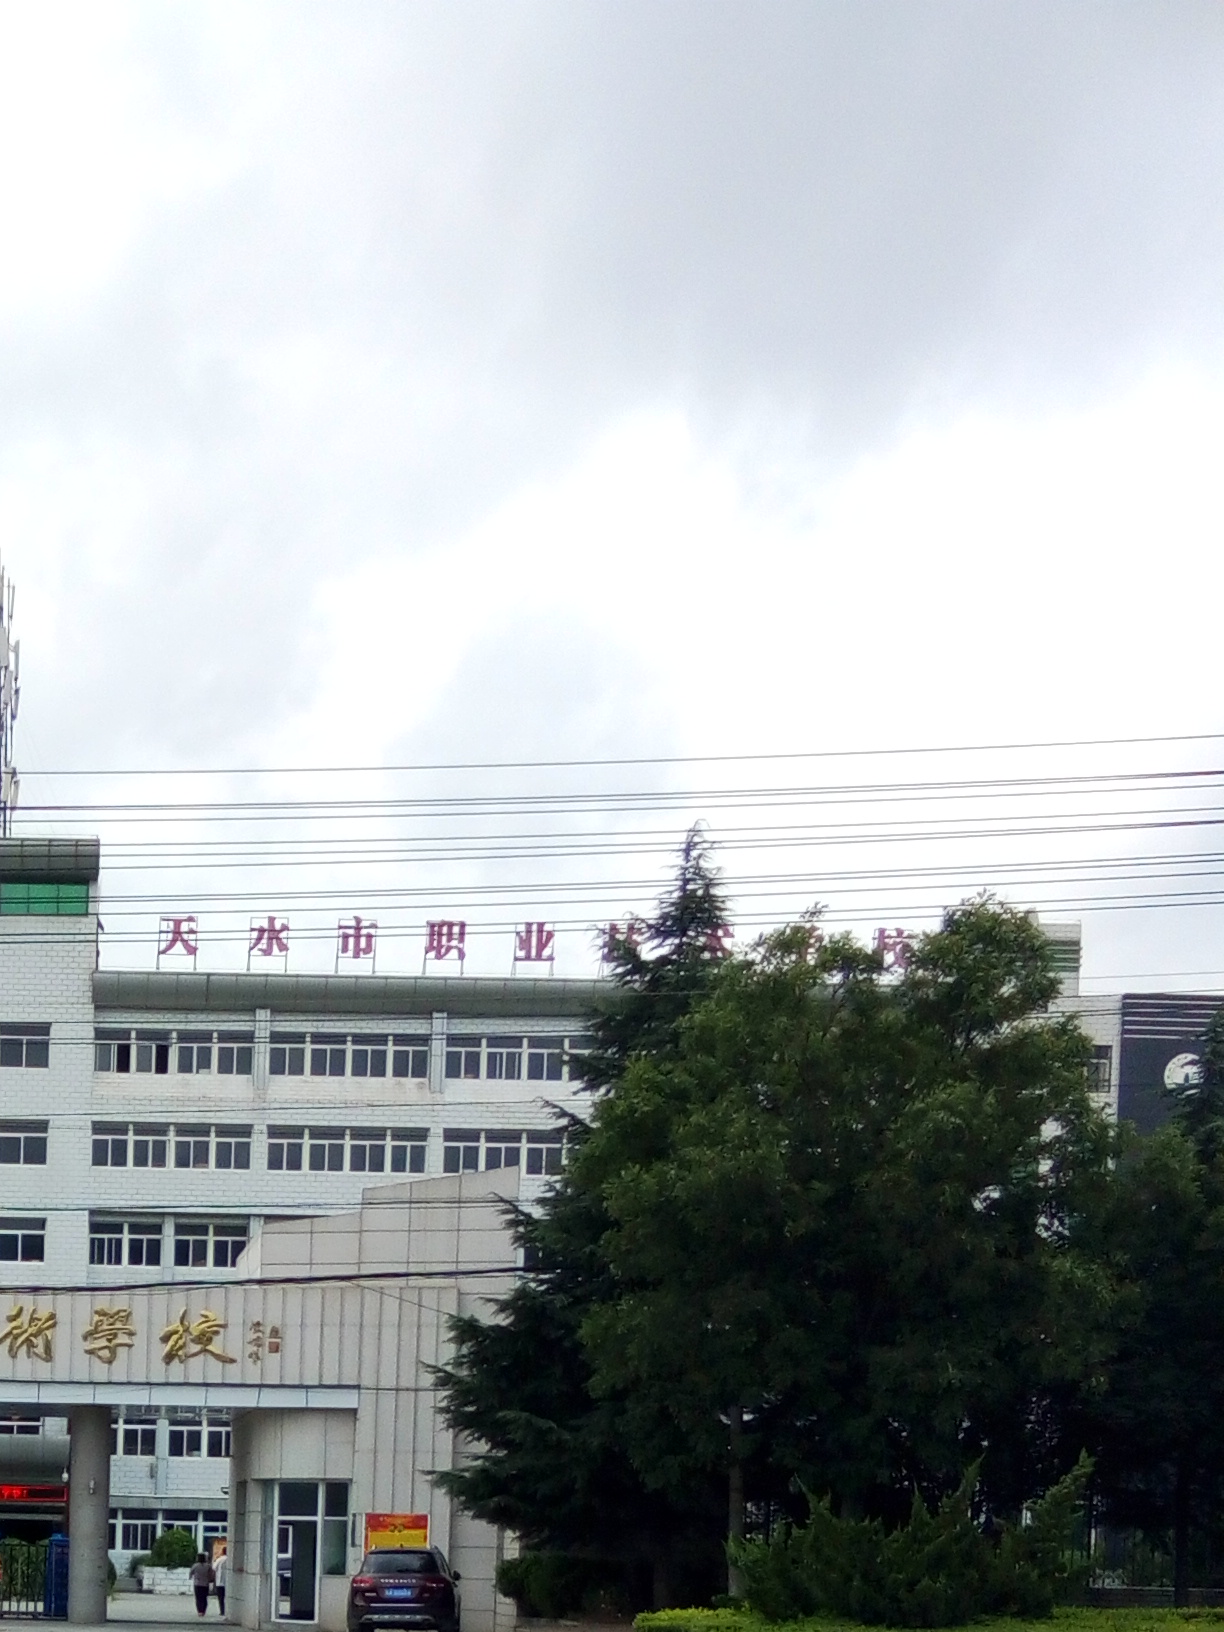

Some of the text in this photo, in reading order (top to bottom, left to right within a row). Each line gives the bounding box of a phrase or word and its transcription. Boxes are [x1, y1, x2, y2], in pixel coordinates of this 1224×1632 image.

[159, 915, 914, 972] 天水市职业校
